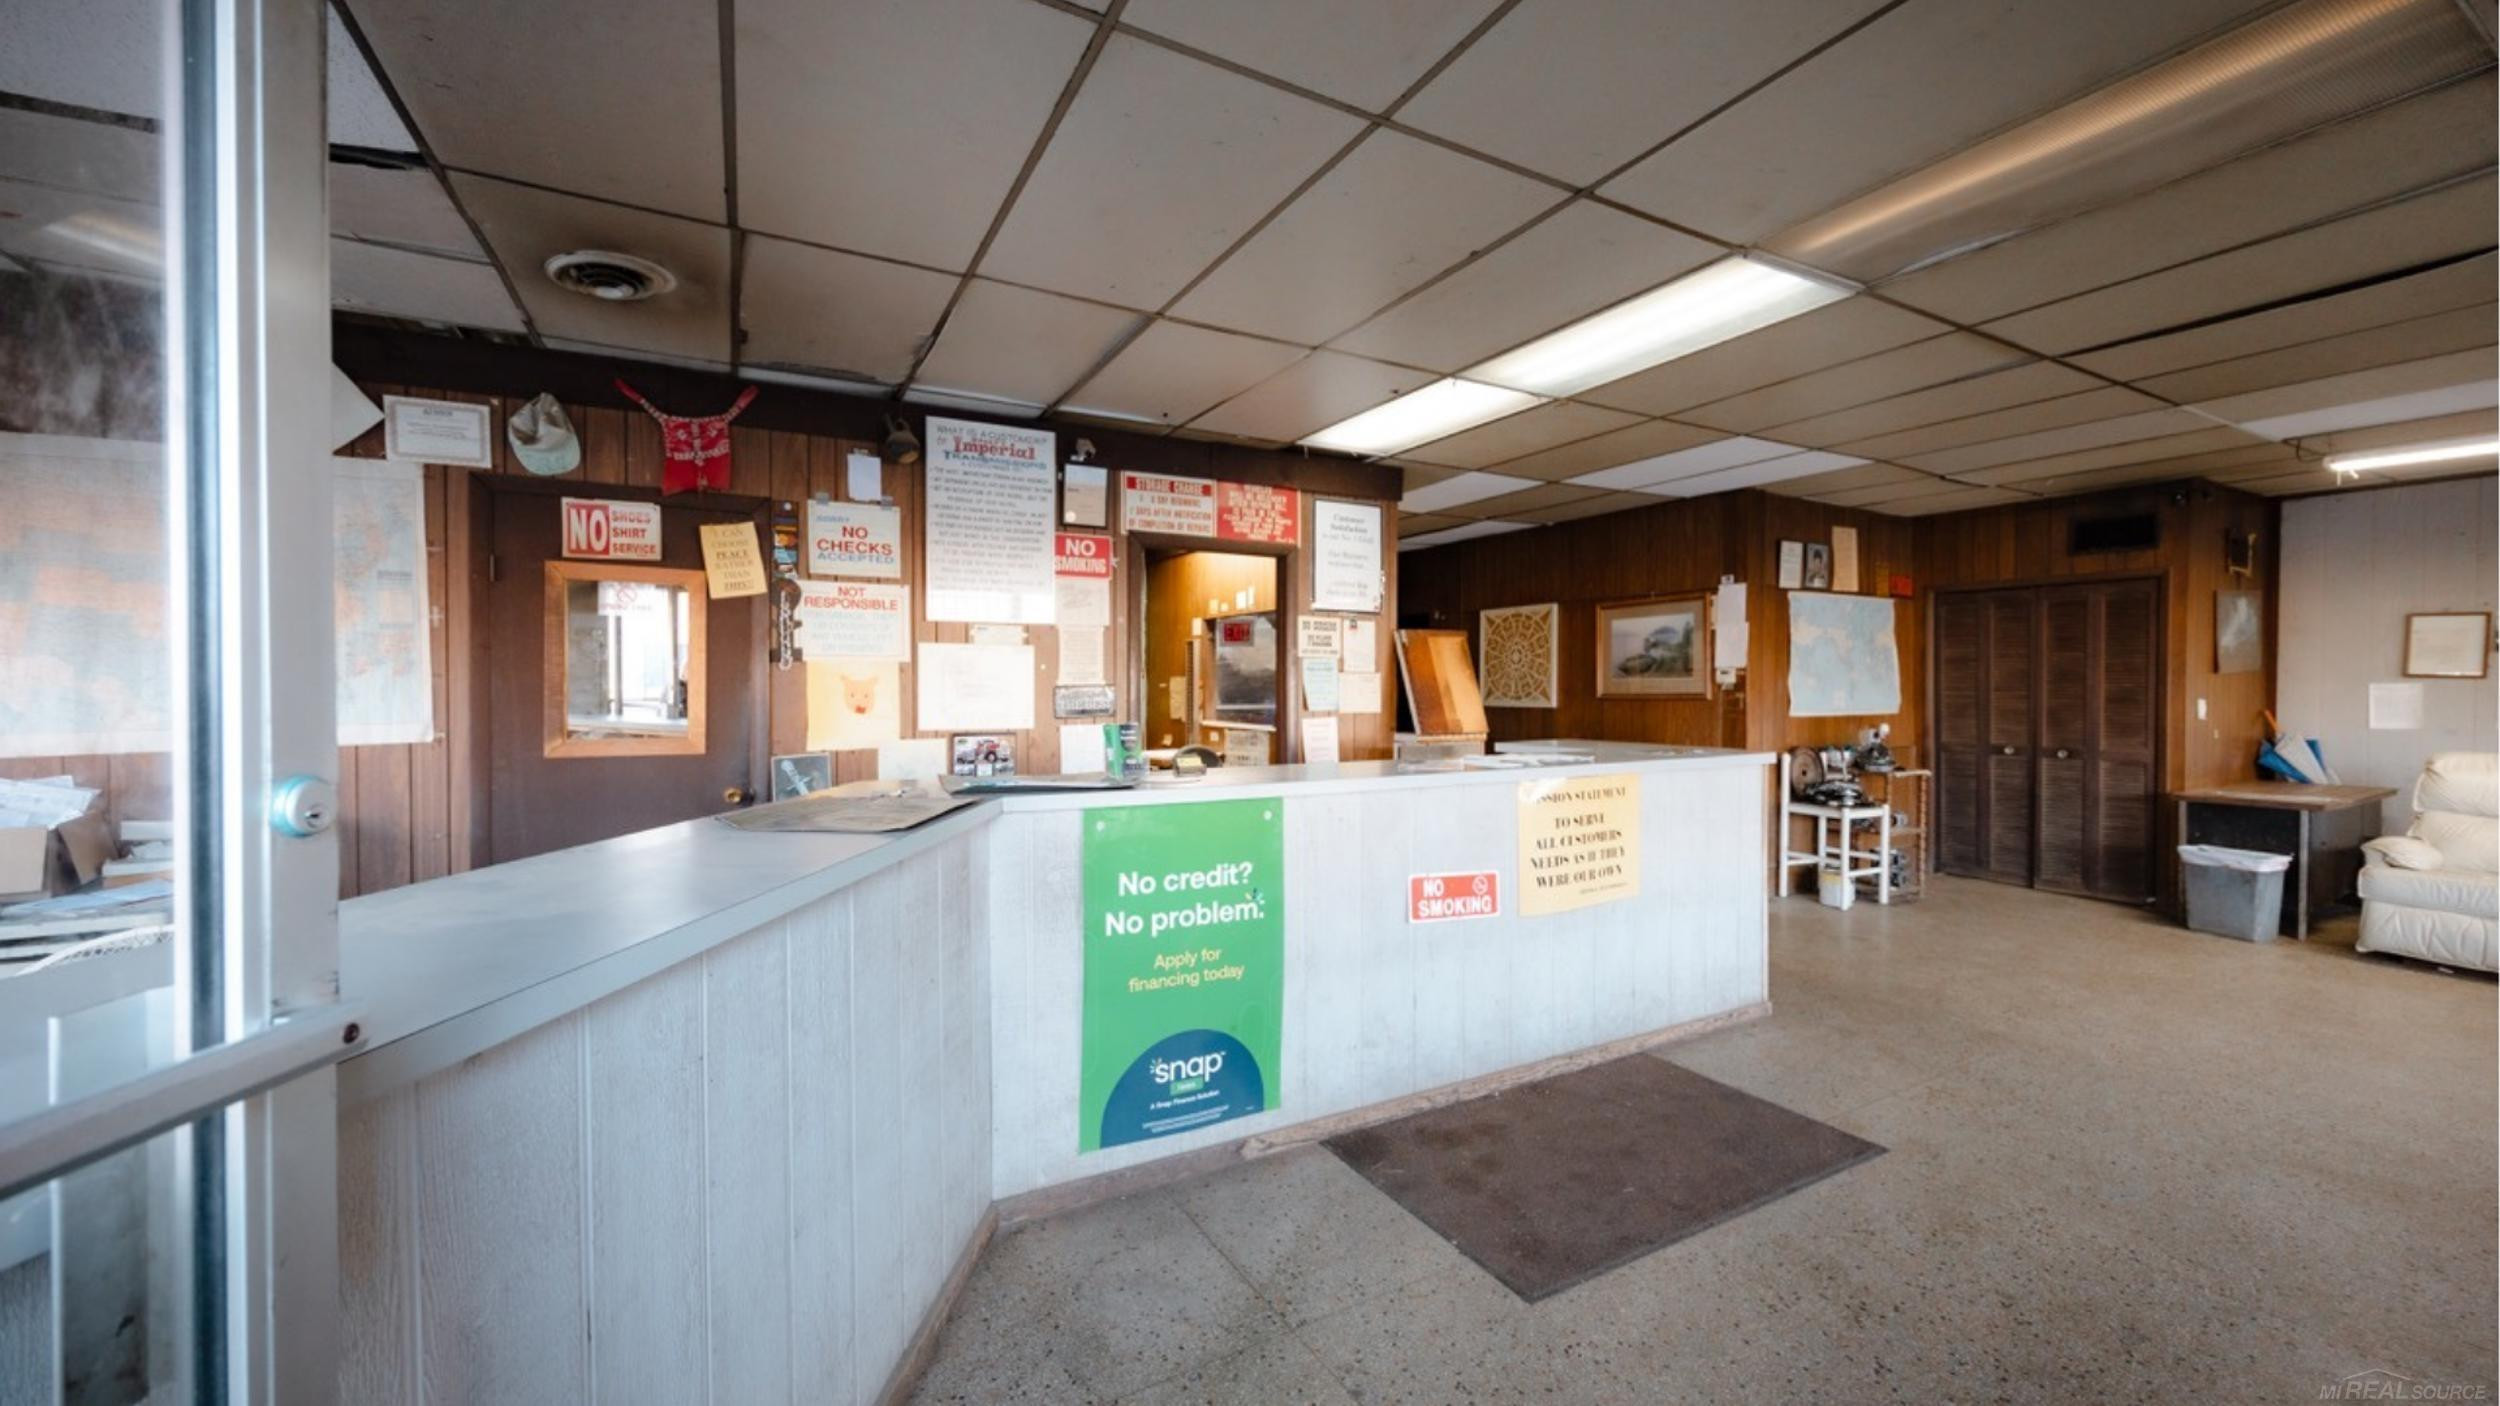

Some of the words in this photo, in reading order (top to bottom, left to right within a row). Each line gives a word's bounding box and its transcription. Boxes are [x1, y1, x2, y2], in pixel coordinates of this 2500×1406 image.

[937, 425, 963, 433] WHAT
[953, 436, 1036, 460] Imperial
[1136, 477, 1170, 492] STORAGE
[1174, 481, 1202, 495] CHARGE
[612, 510, 652, 523] SHOES
[570, 507, 608, 551] NO
[612, 527, 648, 539] SHIRT
[842, 526, 868, 539] NO
[612, 543, 657, 555] SERVICE
[716, 549, 748, 560] PEACE
[816, 538, 893, 556] CHECKS
[1065, 539, 1096, 556] NO
[817, 553, 894, 564] ACCEPTED
[1055, 556, 1107, 574] SMOKING
[838, 586, 866, 597] NOT
[804, 596, 898, 611] RESPONSIBLE
[1225, 624, 1250, 641] EXIT
[1575, 787, 1626, 800] STATEMENT
[1555, 817, 1571, 829] TO
[1573, 813, 1605, 827] SERVE
[1536, 838, 1558, 850] ALL
[1560, 830, 1622, 847] CUSTOMERS
[1530, 855, 1570, 870] NEEDS
[1574, 853, 1586, 864] AS
[1588, 851, 1597, 862] IF
[1600, 846, 1625, 861] THEY
[1118, 871, 1156, 896] No
[1163, 861, 1253, 892] credit?
[1536, 872, 1572, 889] WERE
[1574, 868, 1597, 882] OUR
[1599, 864, 1623, 879] OWN
[1423, 879, 1445, 897] NO
[1417, 895, 1492, 918] SMOKING
[1105, 911, 1144, 936] No
[1151, 901, 1265, 938] problem.
[1154, 951, 1198, 971] Apply
[1201, 948, 1223, 962] for
[1129, 970, 1200, 992] financing
[1204, 964, 1245, 982] today
[1154, 1052, 1223, 1083] snap
